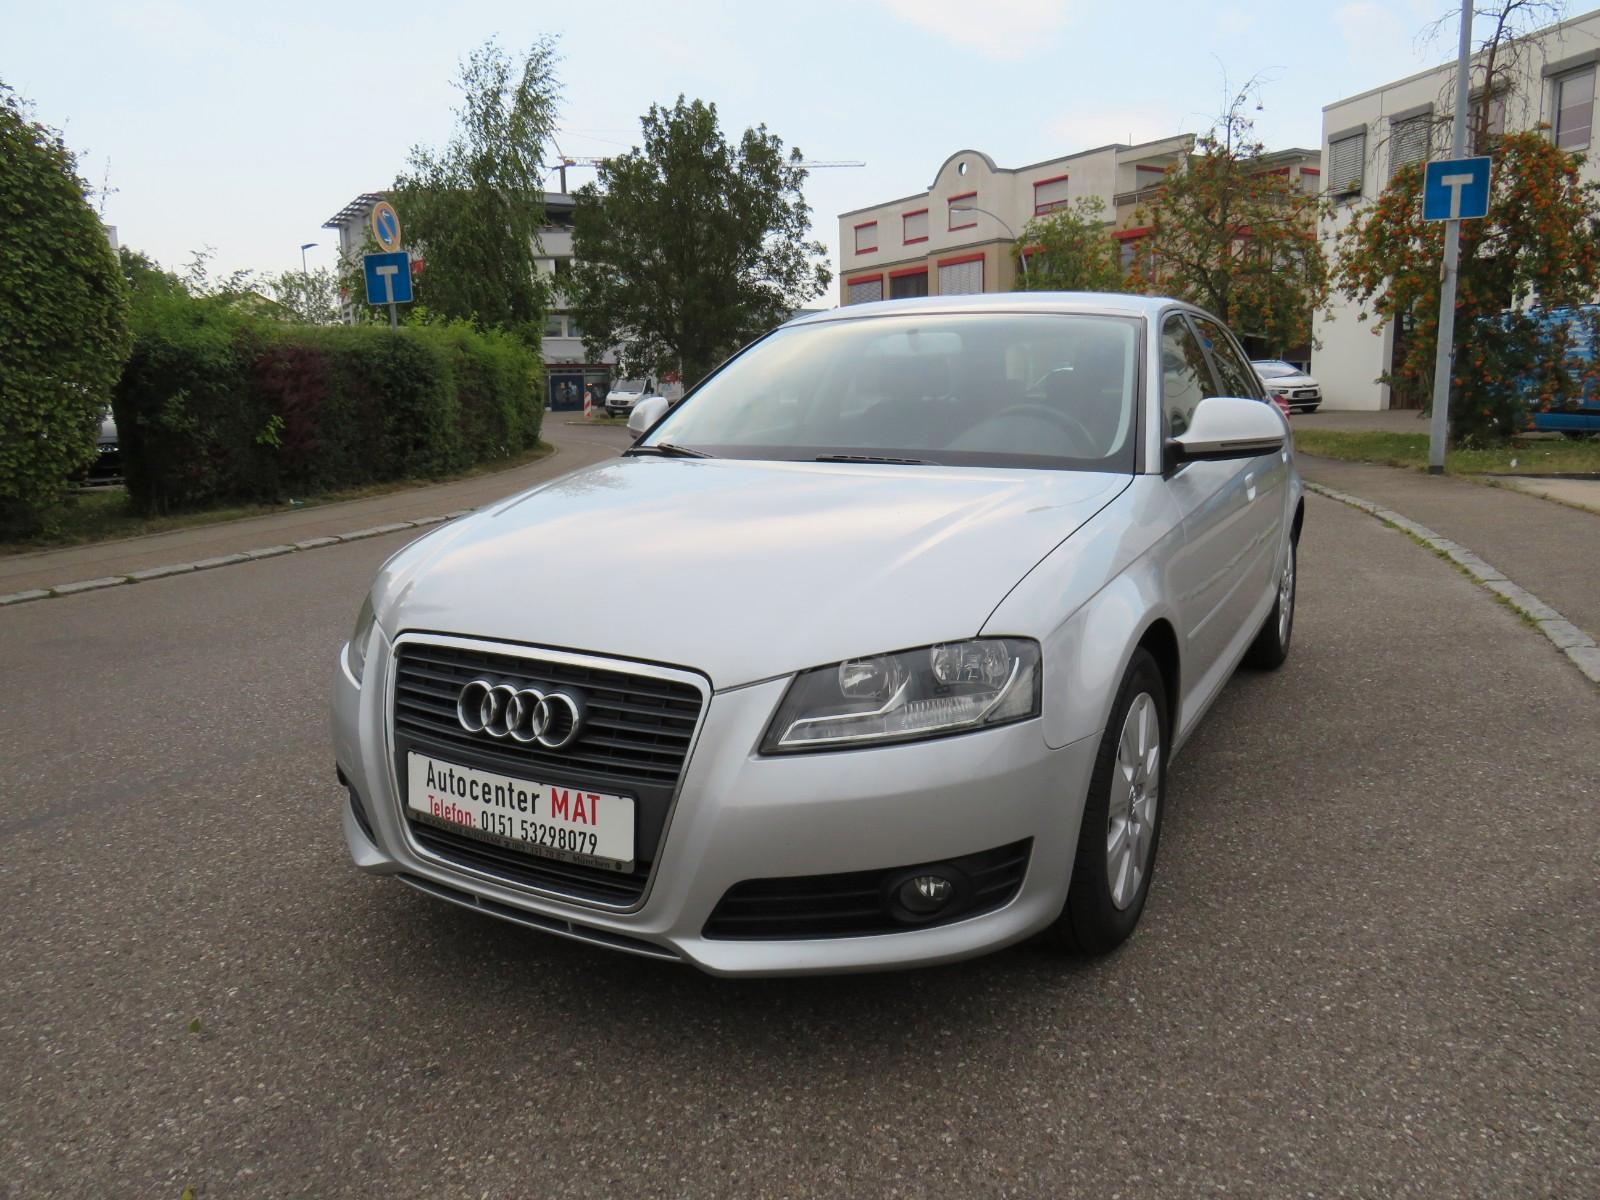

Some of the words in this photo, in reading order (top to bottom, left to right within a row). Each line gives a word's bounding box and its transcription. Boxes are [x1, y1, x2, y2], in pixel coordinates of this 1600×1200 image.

[427, 760, 540, 814] Autocenter
[551, 787, 600, 826] MAT
[428, 795, 476, 828] Telefon:
[481, 811, 513, 837] 0151
[521, 820, 598, 855] 53298079
